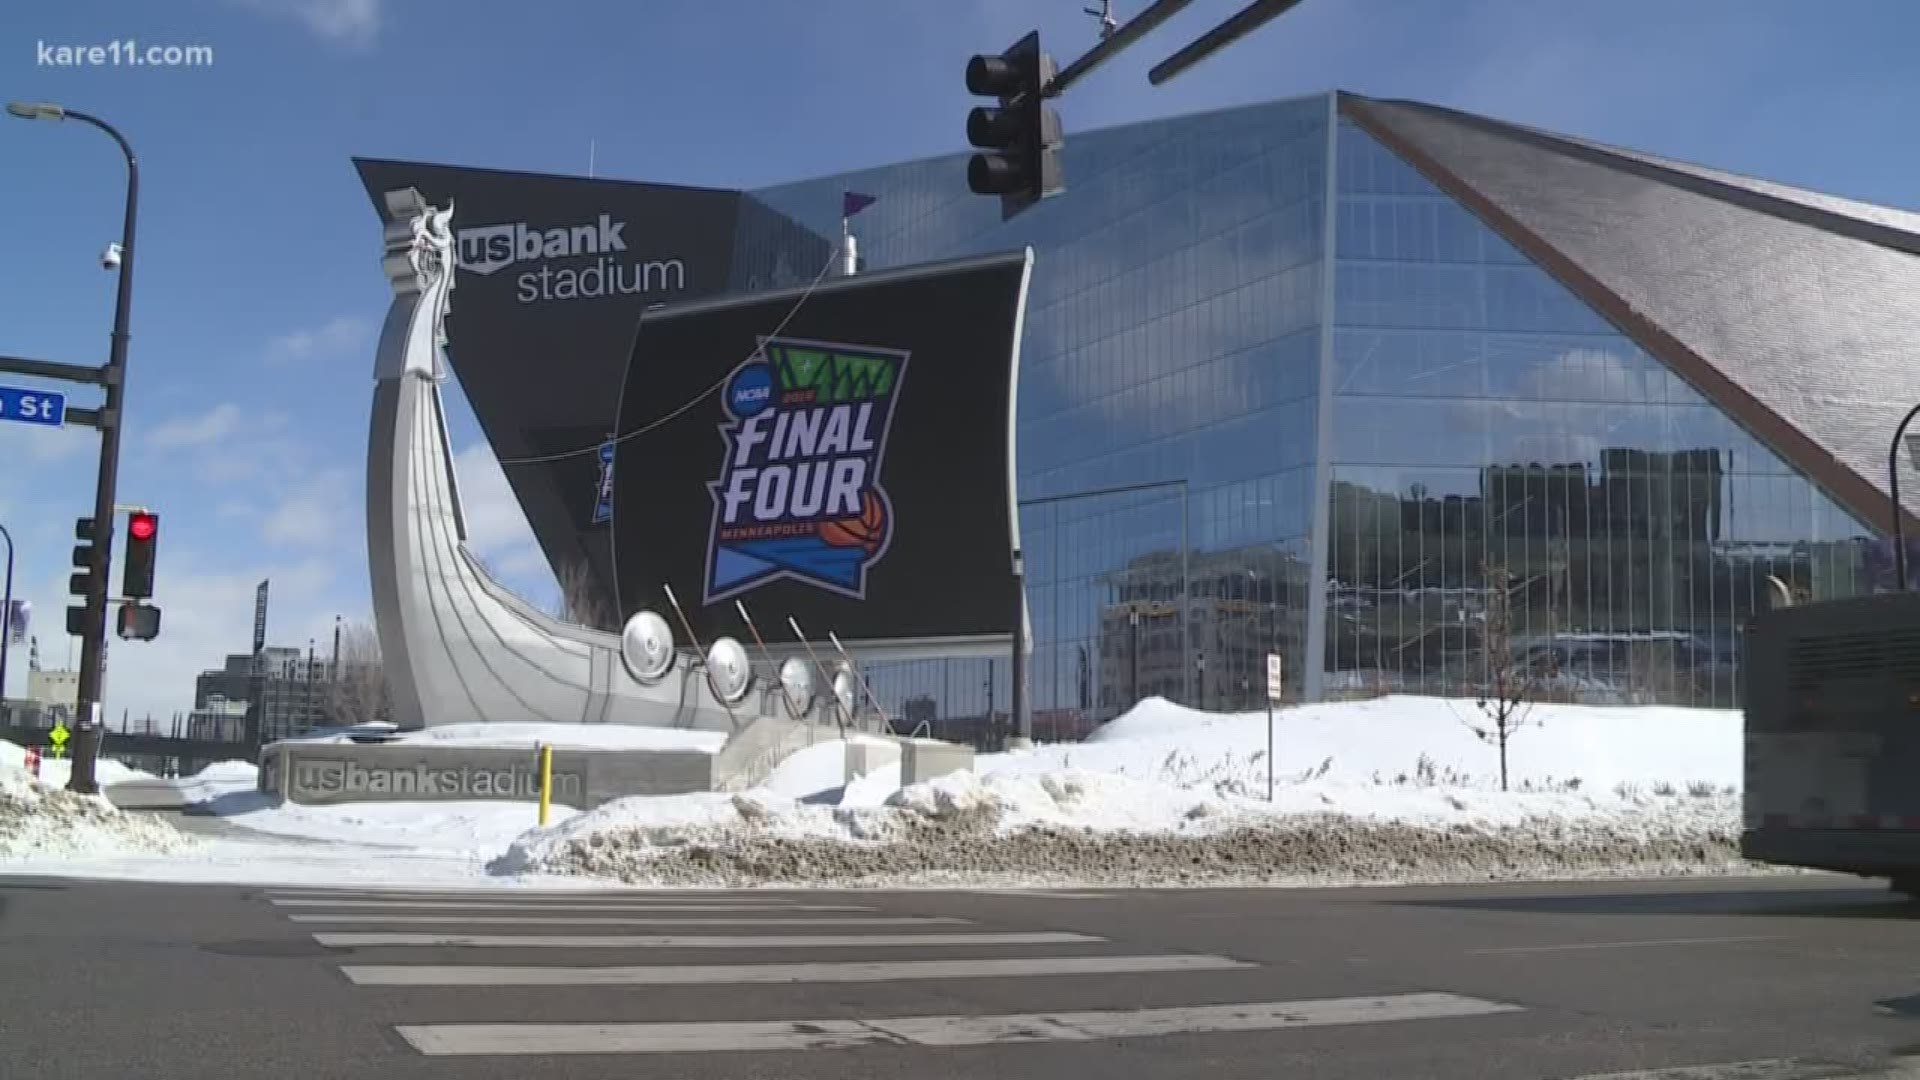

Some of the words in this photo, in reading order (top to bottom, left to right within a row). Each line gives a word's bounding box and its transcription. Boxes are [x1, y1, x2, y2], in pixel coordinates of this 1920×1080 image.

[517, 257, 684, 301] stadium
[20, 395, 53, 419] St
[734, 402, 874, 467] FINAL
[723, 458, 867, 523] FOUR
